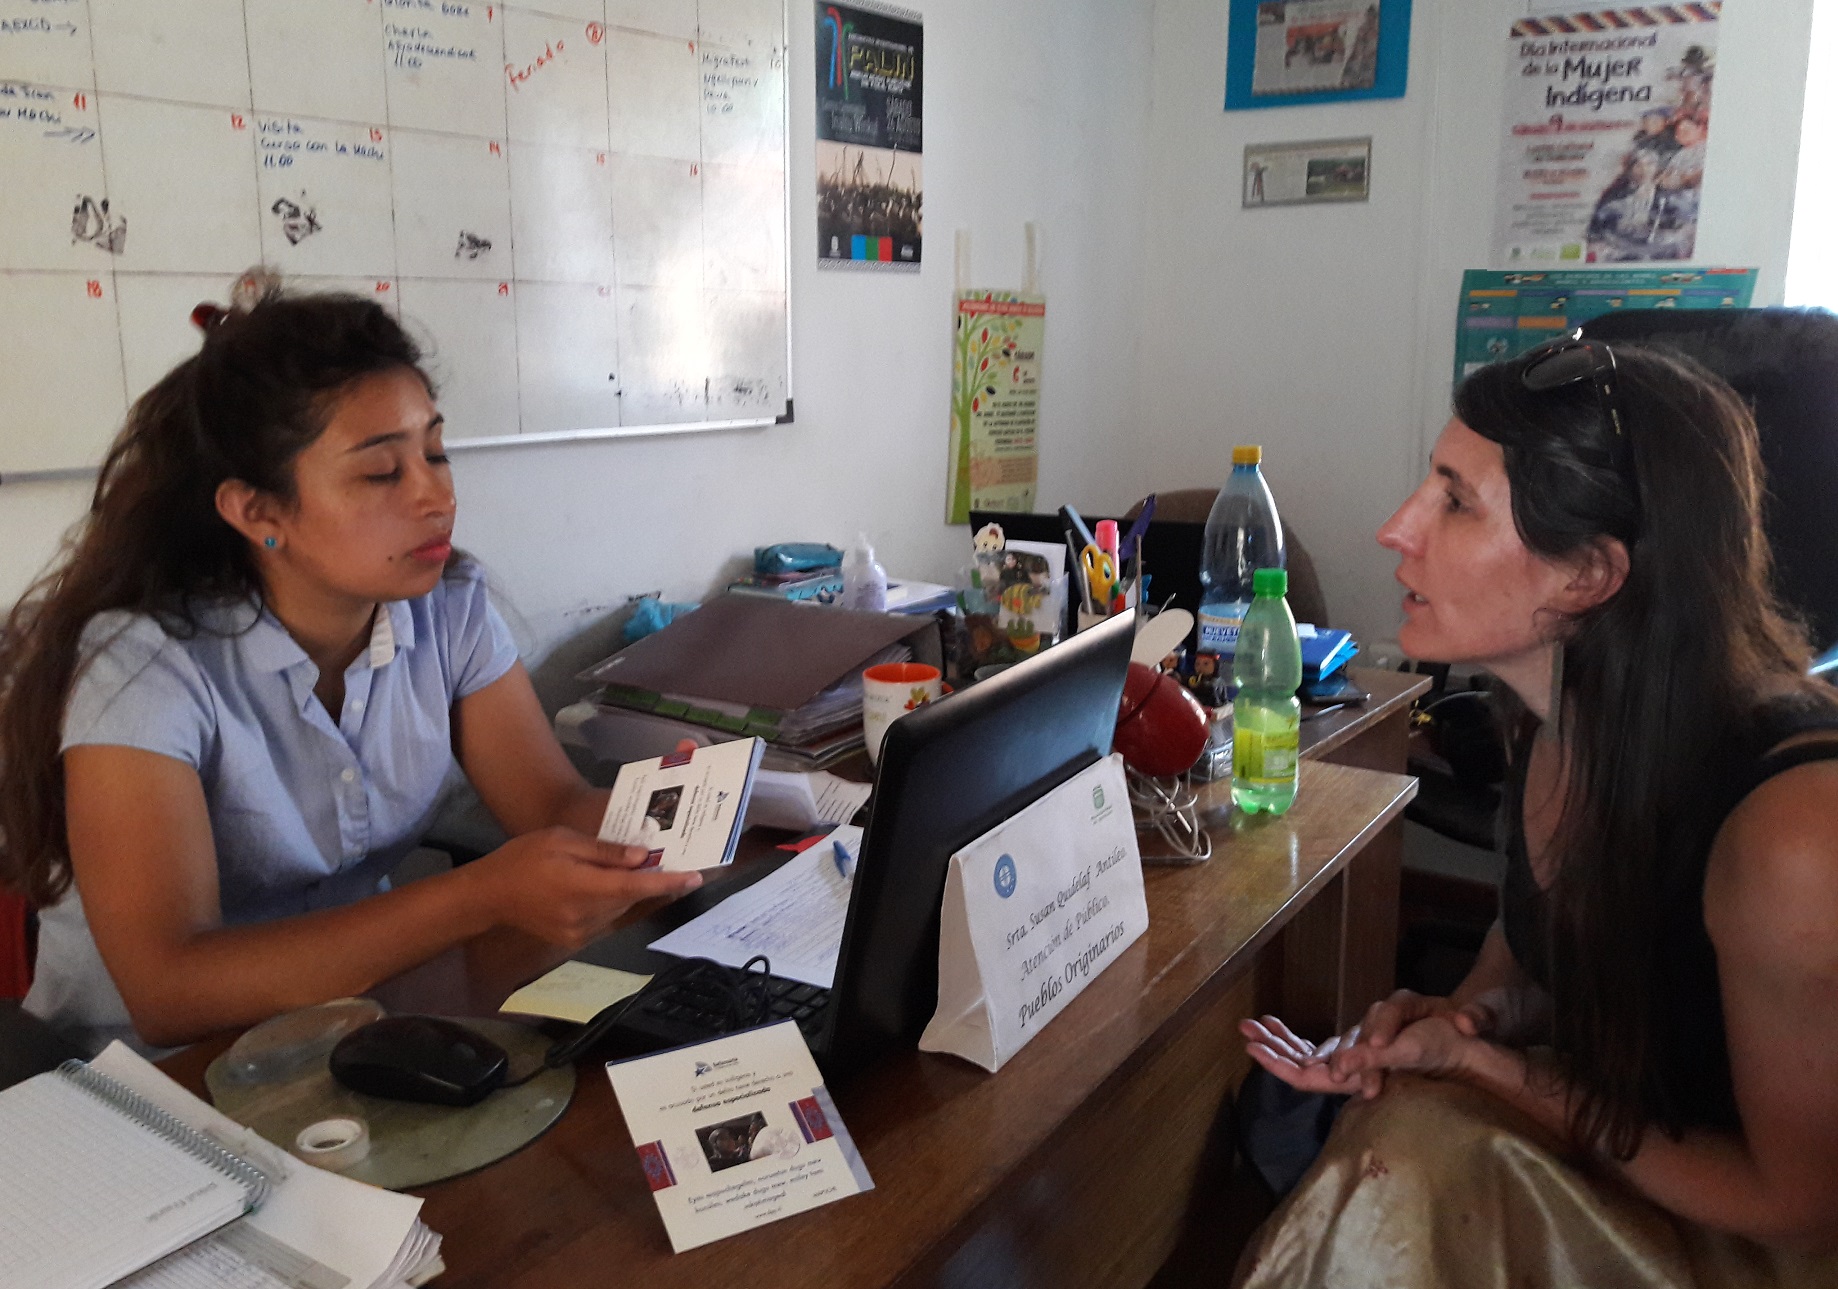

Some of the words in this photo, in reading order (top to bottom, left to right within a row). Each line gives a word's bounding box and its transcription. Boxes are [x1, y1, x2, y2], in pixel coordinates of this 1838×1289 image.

[1548, 33, 1657, 54] Internacional
[504, 40, 564, 92] Feriado
[1521, 58, 1542, 76] de
[1545, 59, 1559, 76] la
[74, 91, 87, 111] 11
[1546, 81, 1652, 112] Indígena
[231, 113, 246, 130] 12
[258, 118, 303, 134] Visita
[1029, 899, 1056, 931] Susan
[1021, 932, 1062, 981] Atención
[1063, 918, 1073, 941] de
[1019, 975, 1063, 1029] Pueblos
[1064, 920, 1125, 985] Originarios
